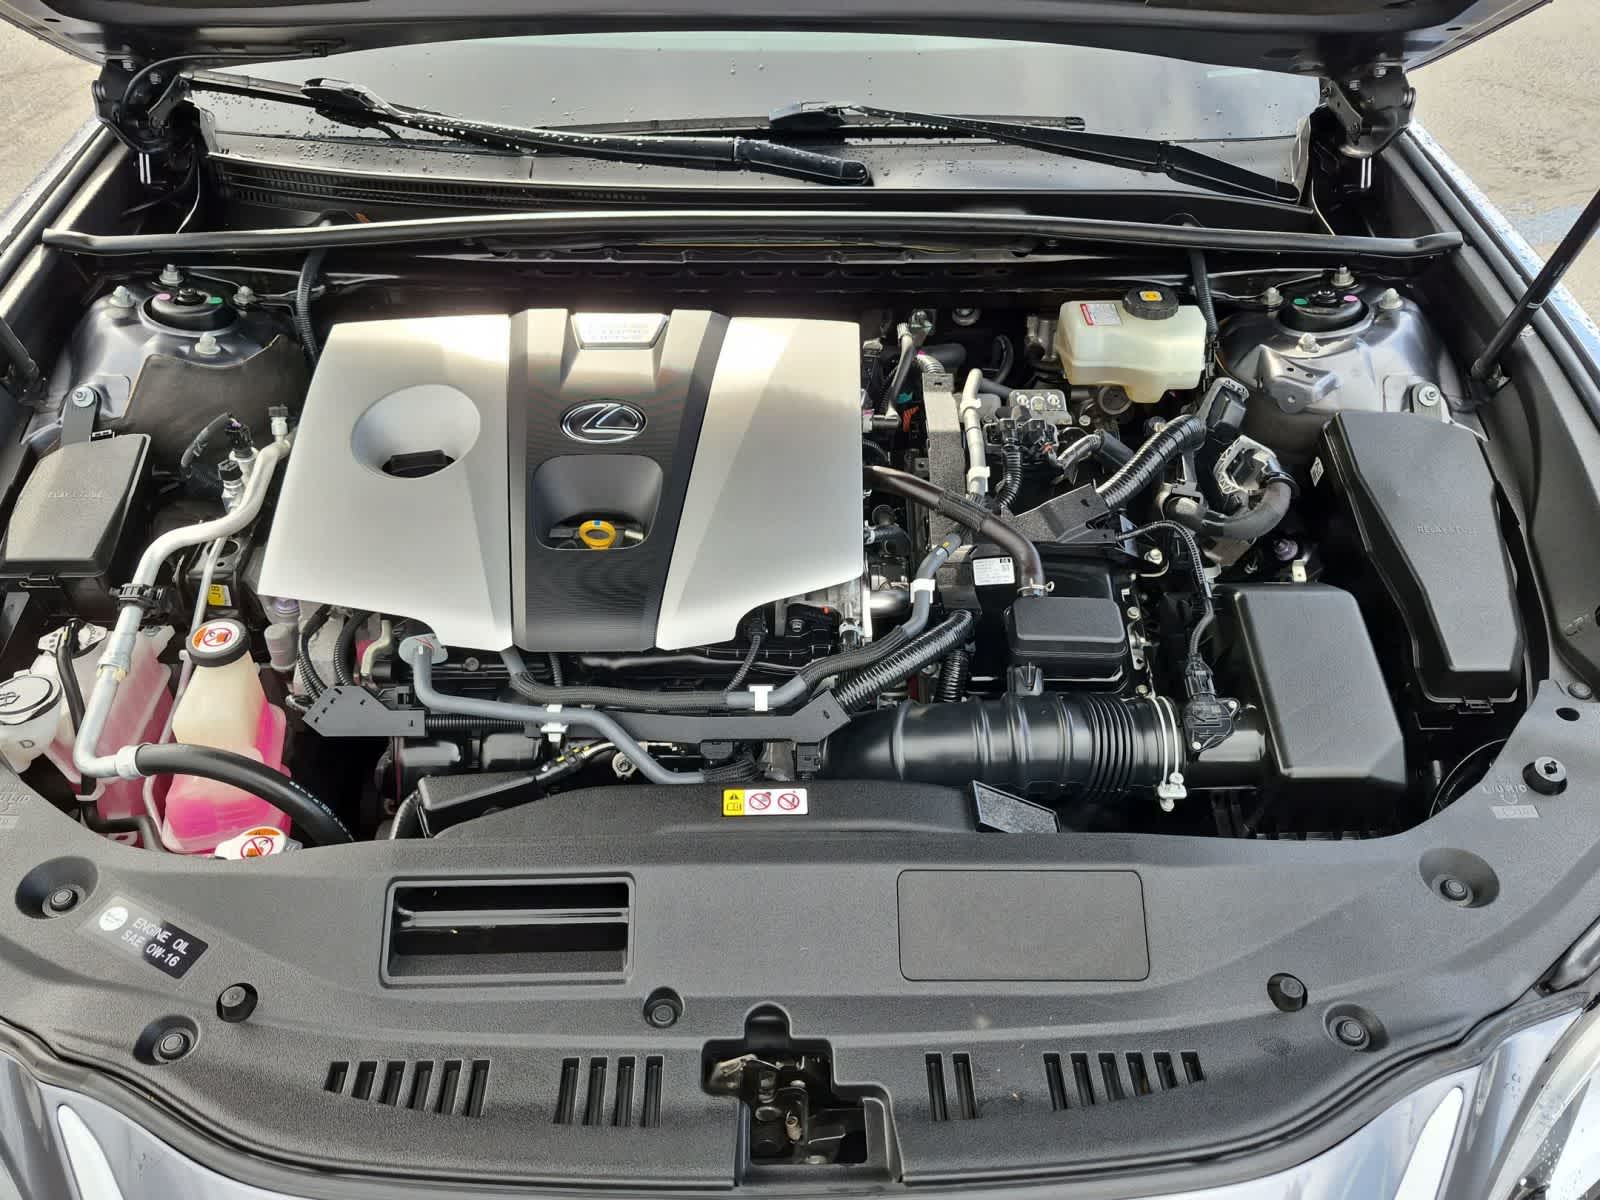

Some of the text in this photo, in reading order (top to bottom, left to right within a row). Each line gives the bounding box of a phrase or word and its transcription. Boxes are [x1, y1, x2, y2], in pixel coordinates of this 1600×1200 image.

[121, 929, 146, 948] SAE
[132, 917, 172, 943] ENGINE
[172, 938, 190, 955] OIL
